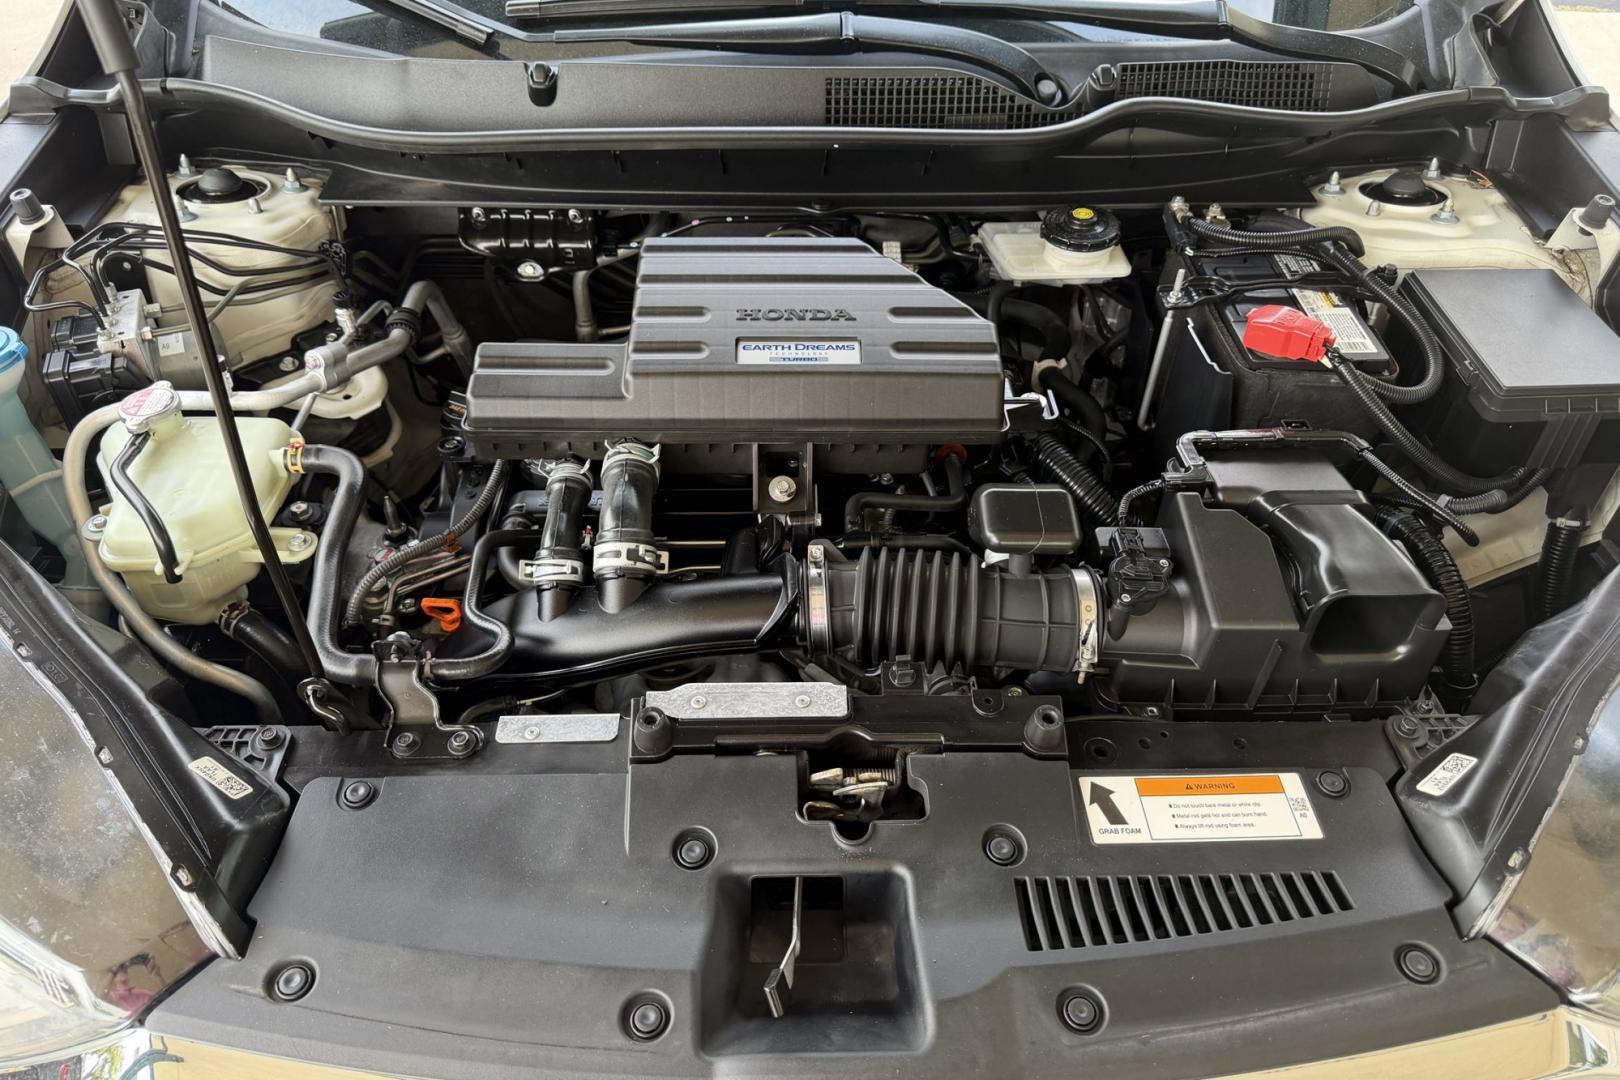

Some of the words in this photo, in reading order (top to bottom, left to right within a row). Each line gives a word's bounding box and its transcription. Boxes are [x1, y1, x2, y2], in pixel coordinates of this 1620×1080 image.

[736, 308, 857, 321] HONDA
[742, 343, 791, 351] EARTH
[794, 343, 856, 351] DREAMS
[1193, 782, 1236, 790] WARNING
[1098, 827, 1119, 835] GRAB
